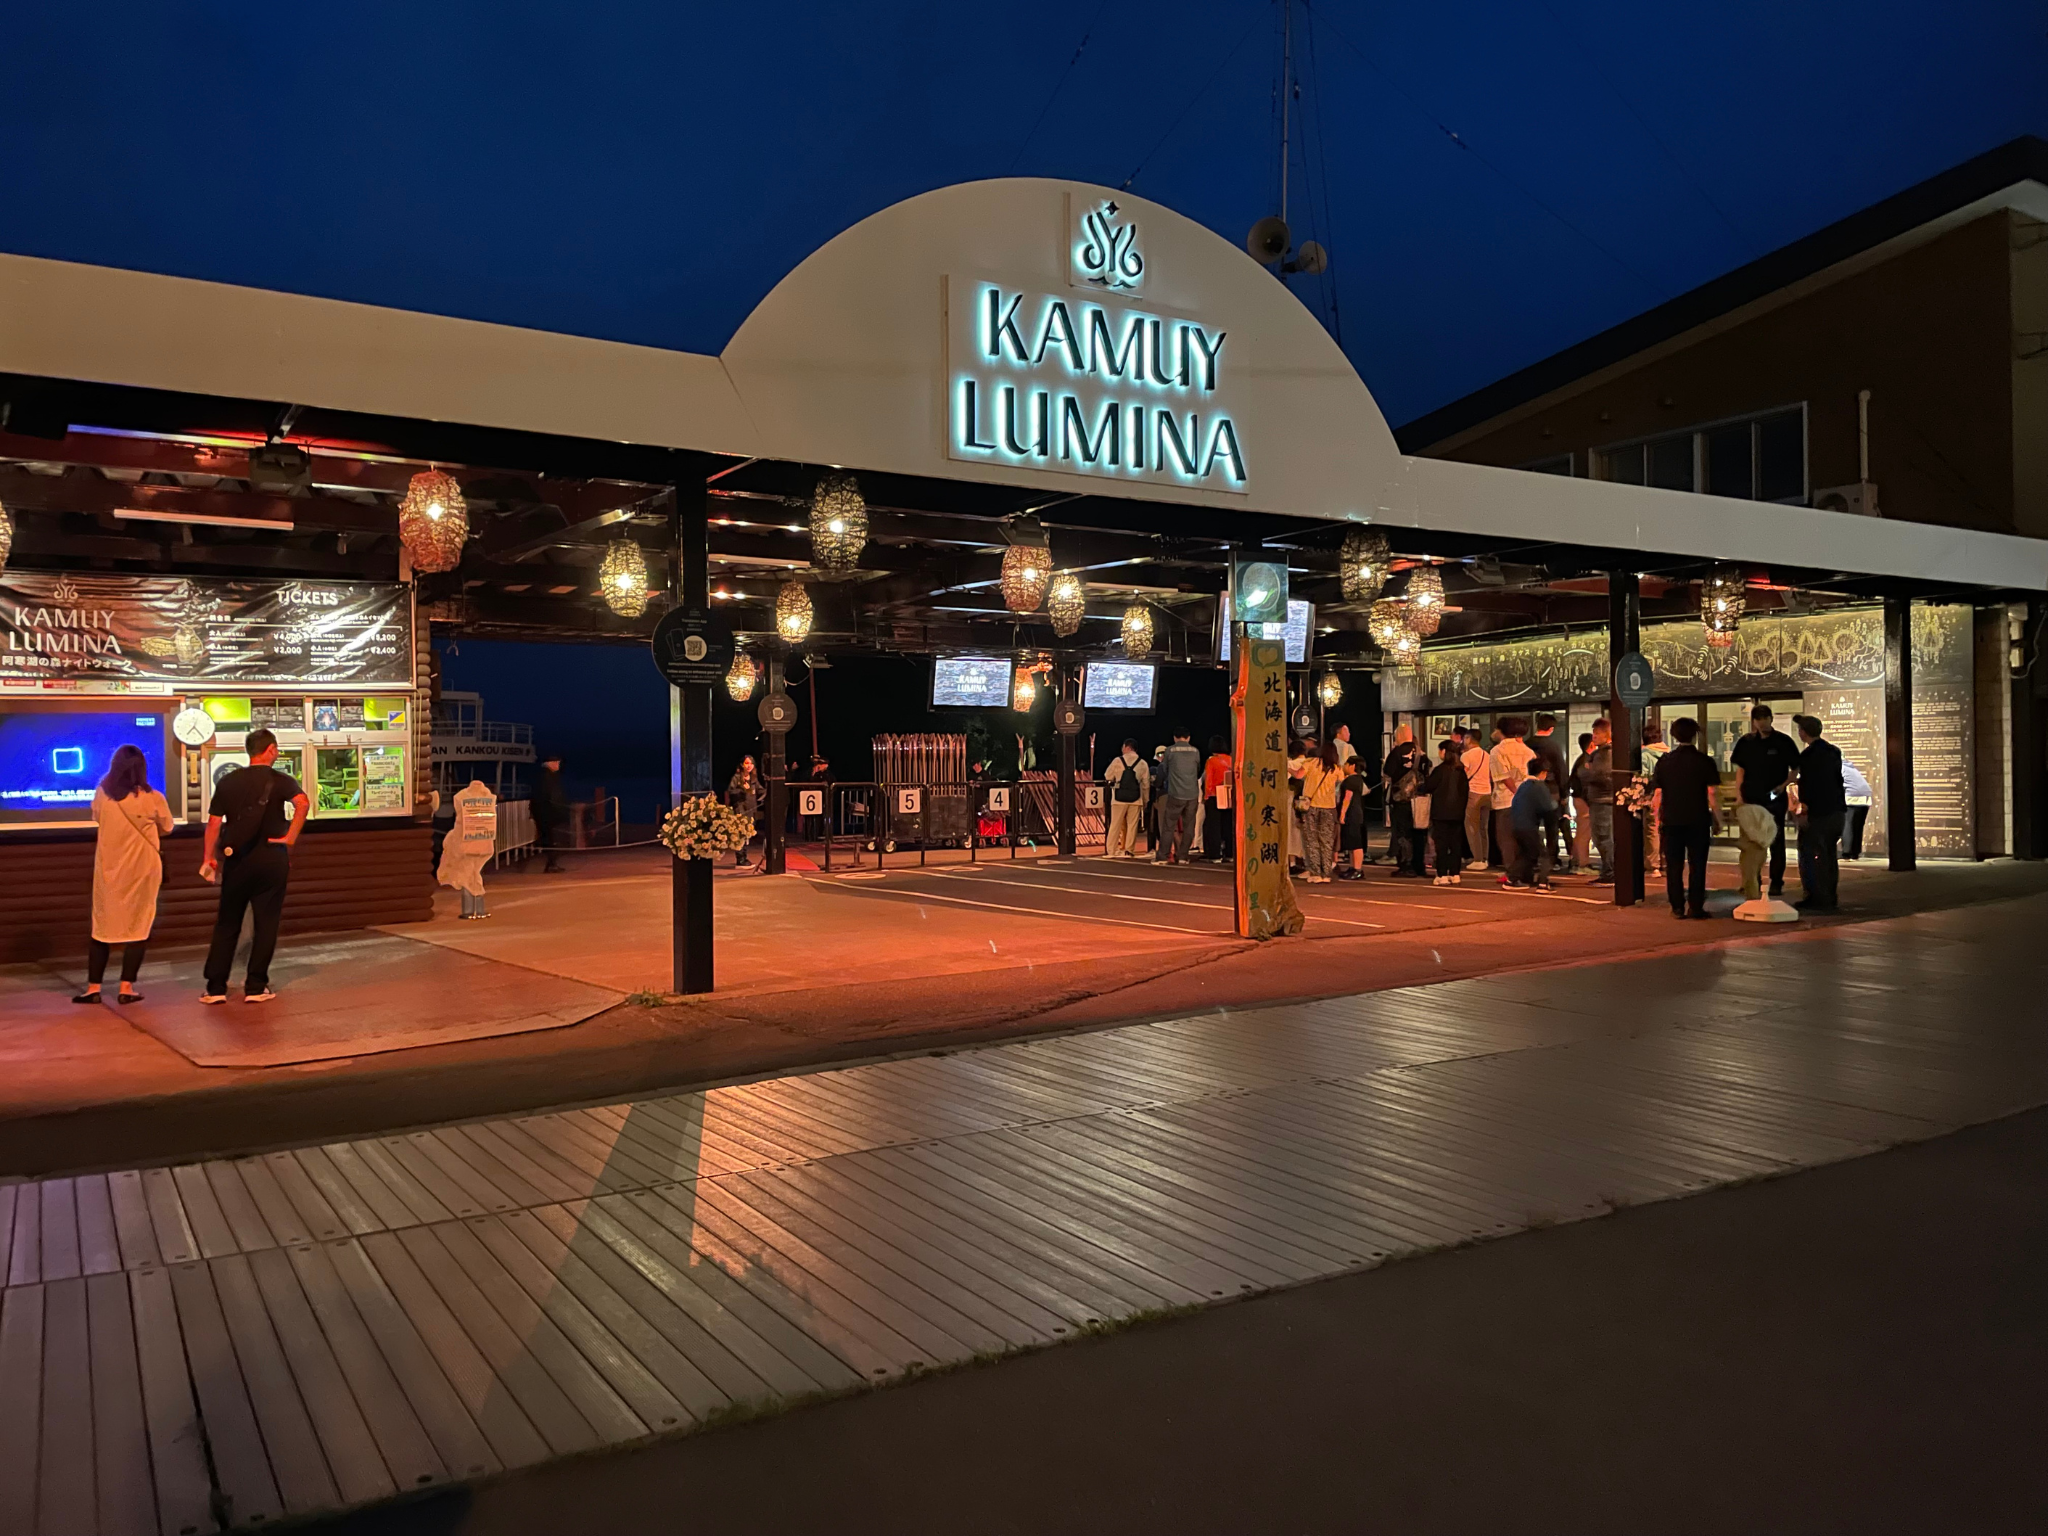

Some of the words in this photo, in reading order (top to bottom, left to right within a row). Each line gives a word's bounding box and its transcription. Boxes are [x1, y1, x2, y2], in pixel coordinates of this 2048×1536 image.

[988, 288, 1227, 391] KAMUY
[963, 380, 1247, 481] LUMINA
[276, 590, 338, 606] TICKETS
[14, 606, 116, 629] KAMUY
[9, 631, 122, 655] LUMINA
[2, 655, 136, 673] 阿寒湖の森ナイトウォーク
[456, 745, 500, 755] KANKOU
[1259, 671, 1284, 865] 北海道阿寒湖
[805, 794, 816, 811] 6
[904, 793, 914, 810] 5
[993, 790, 1003, 807] 4
[1090, 790, 1099, 805] 3
[1245, 760, 1260, 911] まりもの里
